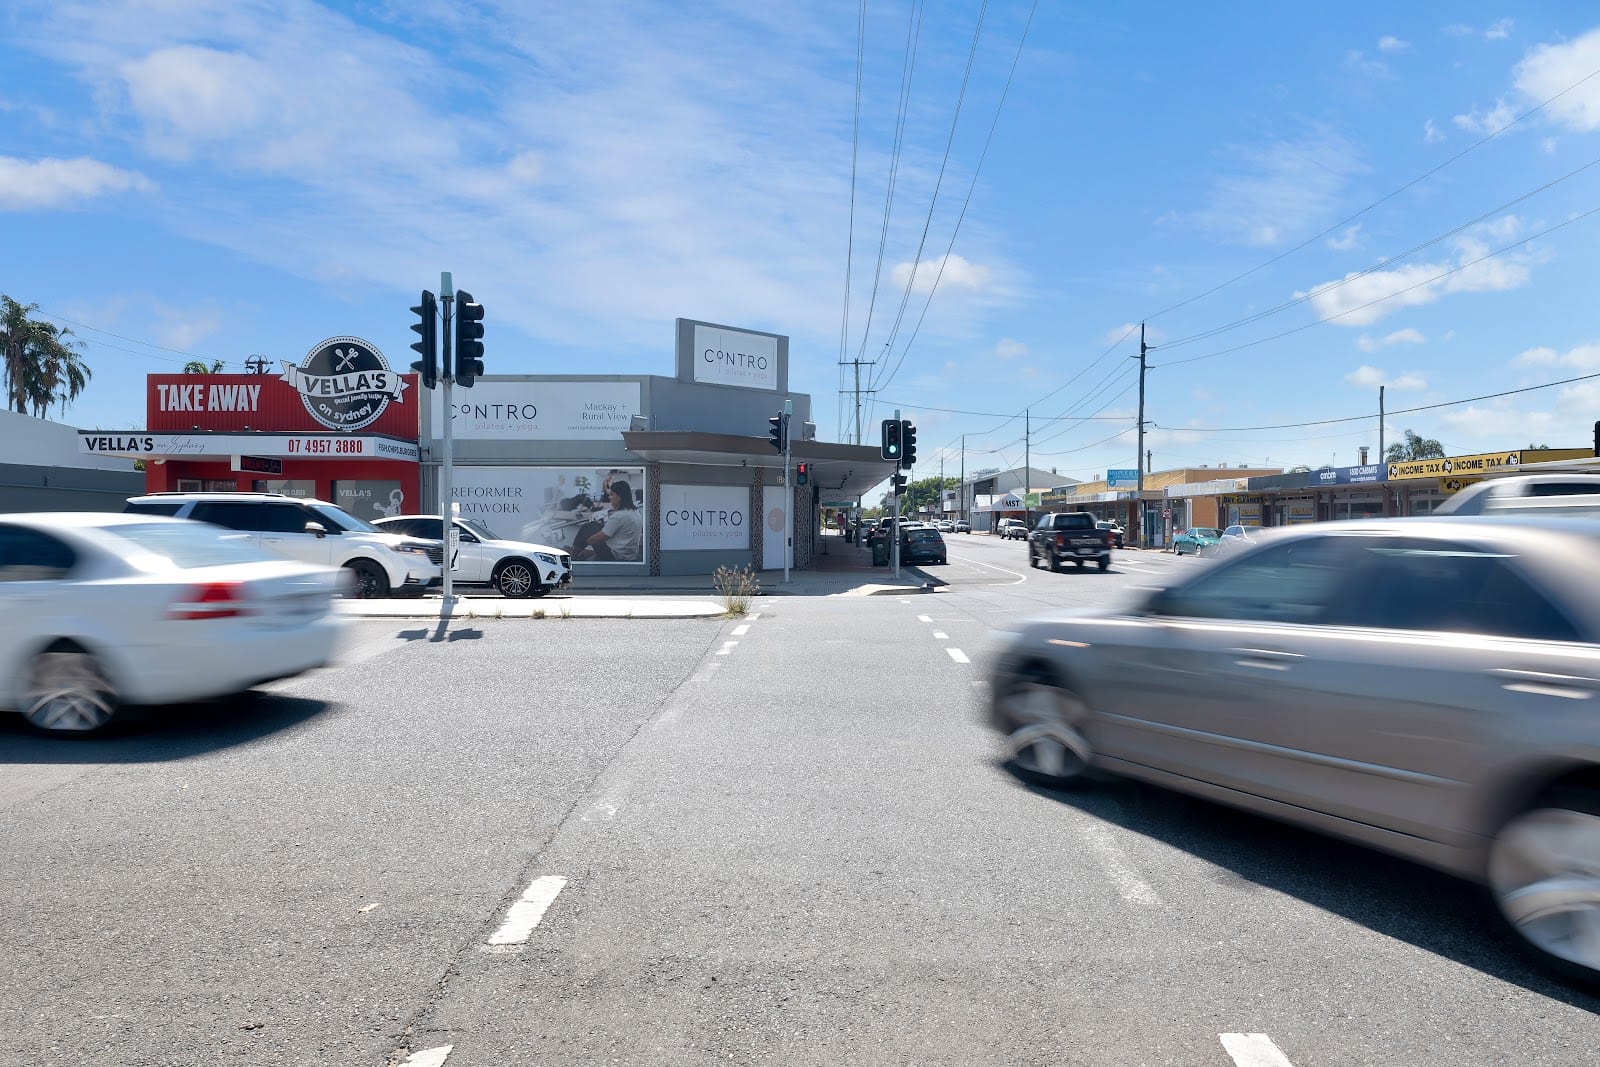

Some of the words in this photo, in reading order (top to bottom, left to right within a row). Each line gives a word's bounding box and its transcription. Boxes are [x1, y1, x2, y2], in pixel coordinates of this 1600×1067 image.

[304, 373, 387, 395] VELLA'S
[157, 384, 204, 411] TAKE
[208, 384, 261, 411] AWAY
[318, 403, 333, 416] on
[333, 403, 372, 422] sydney
[584, 402, 617, 412] Mackay
[582, 412, 605, 421] Rural
[607, 412, 628, 421] View
[474, 422, 504, 431] pilates
[517, 423, 538, 432] yoga
[85, 437, 153, 451] VELLA'S
[288, 440, 301, 453] 07
[305, 440, 332, 453] 4957
[336, 440, 363, 453] 3880
[1399, 465, 1424, 475] INCOME
[1426, 463, 1440, 473] TAX
[1453, 459, 1483, 471] INCOME
[1485, 457, 1502, 467] TAX
[339, 489, 372, 497] VELLA'S
[451, 487, 524, 498] REFORMER
[459, 503, 520, 513] ATWORK
[692, 529, 717, 538] pilates
[726, 531, 743, 539] yoga
